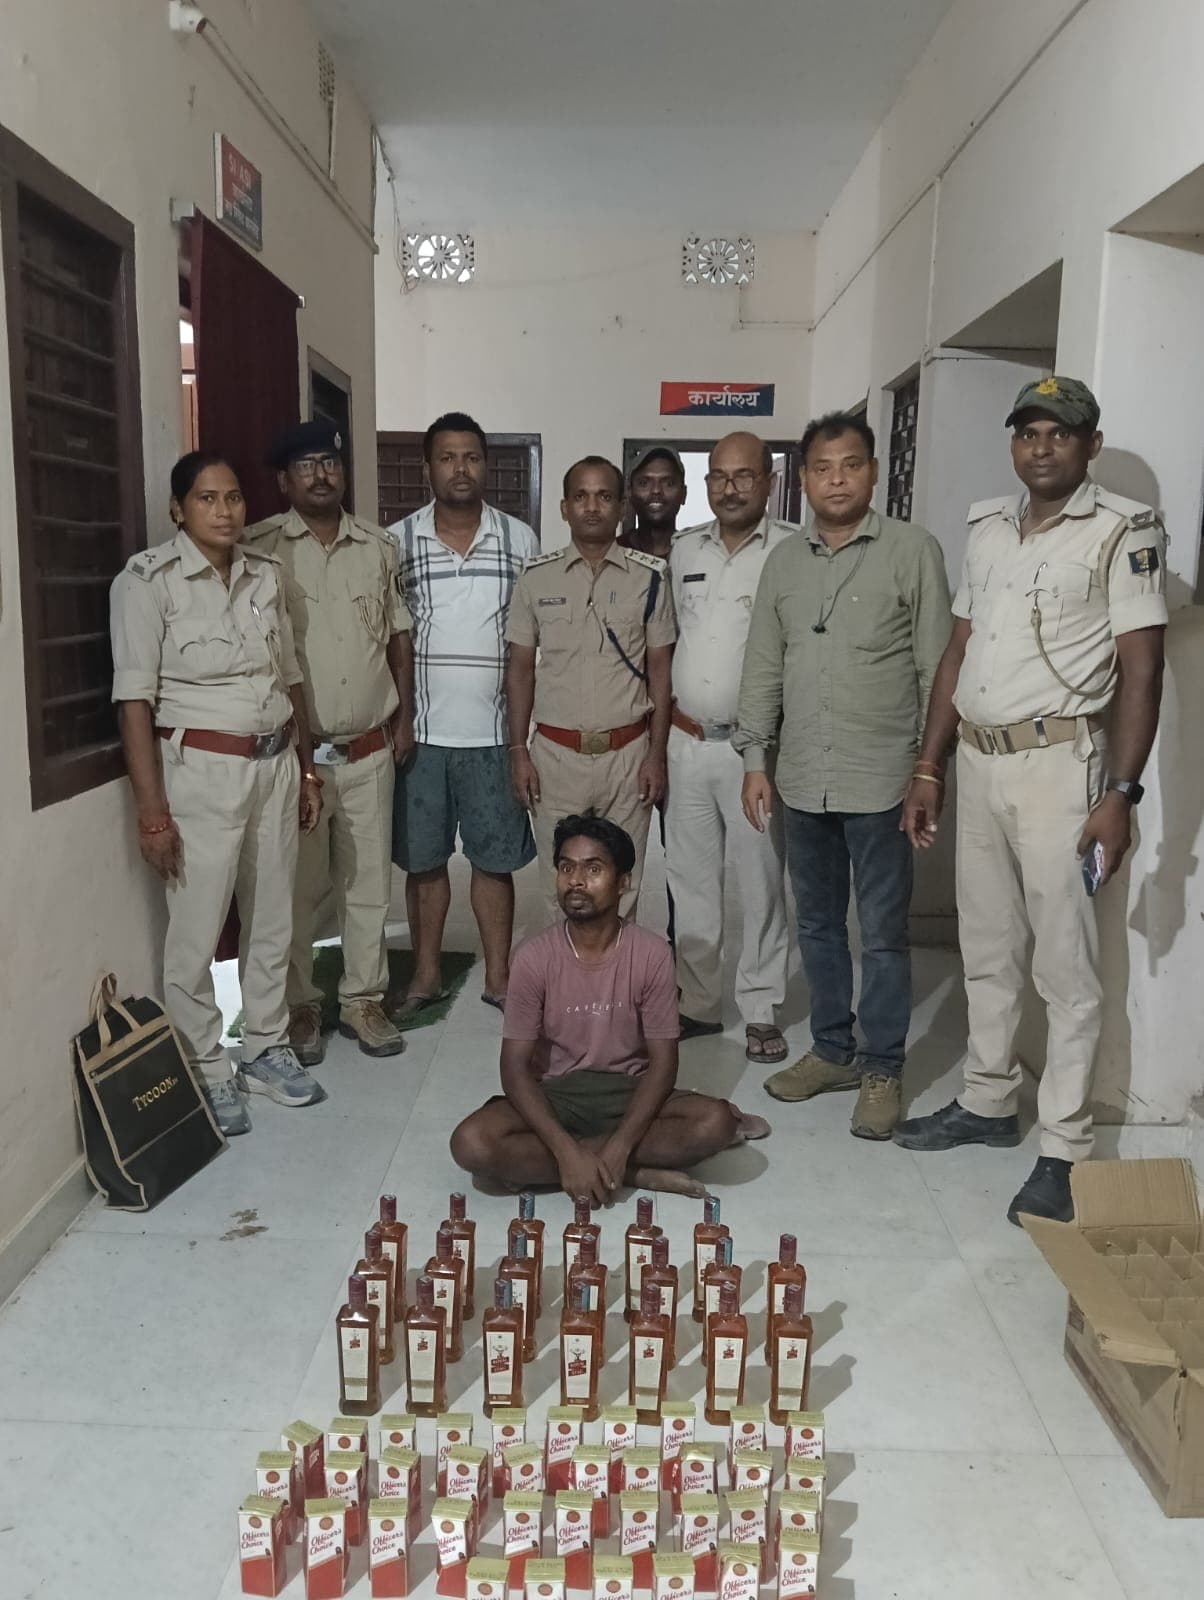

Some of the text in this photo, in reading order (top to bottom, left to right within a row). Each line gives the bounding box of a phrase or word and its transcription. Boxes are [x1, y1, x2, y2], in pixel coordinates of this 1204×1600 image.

[688, 385, 760, 408] कार्यालय
[507, 1533, 530, 1544] Choice
[558, 1534, 580, 1546] Choice
[623, 1534, 646, 1546] Choice
[310, 1541, 333, 1555] Choice
[371, 1542, 396, 1555] Choice
[781, 1577, 806, 1587] Choice
